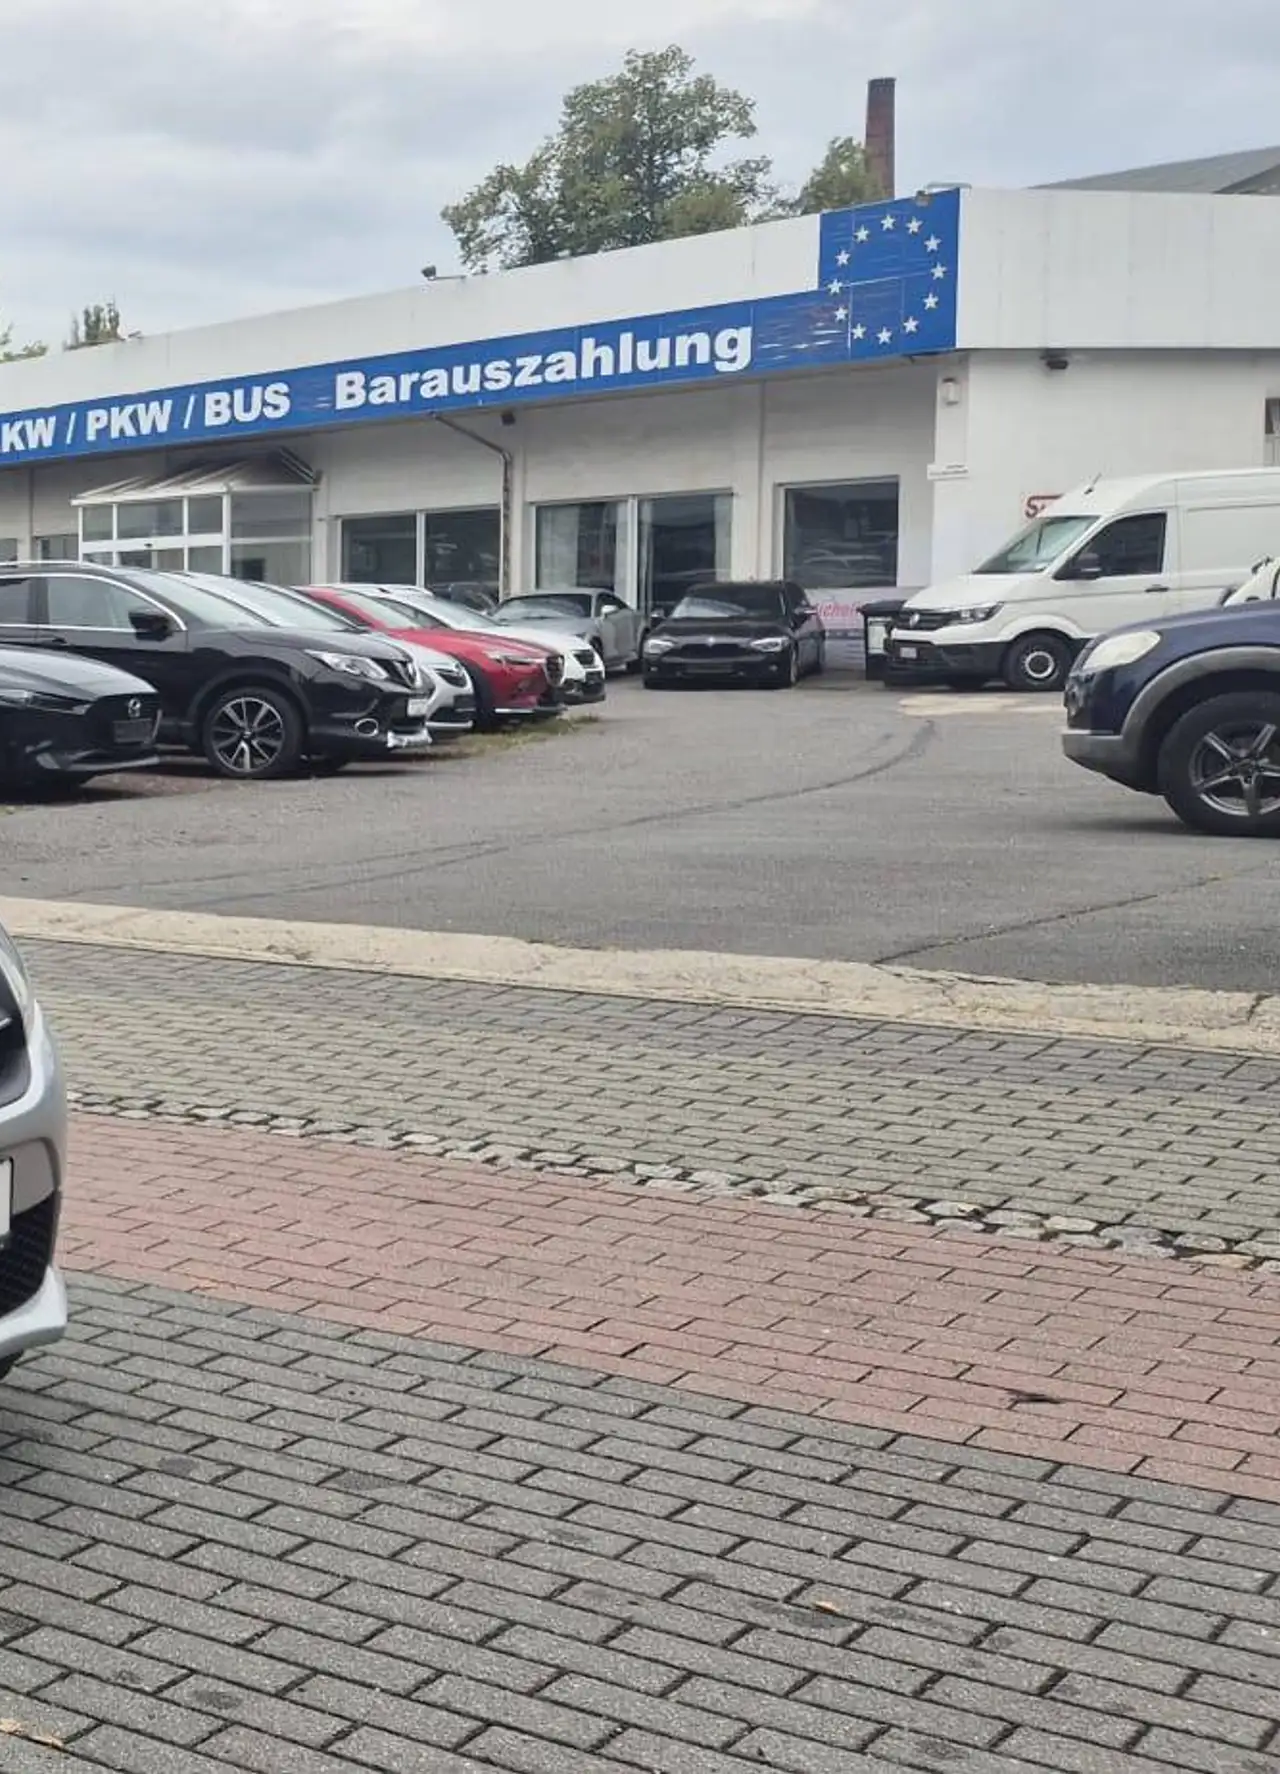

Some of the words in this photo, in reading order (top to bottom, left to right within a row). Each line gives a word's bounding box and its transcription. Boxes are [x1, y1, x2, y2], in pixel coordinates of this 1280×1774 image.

[86, 399, 172, 442] PKW
[204, 382, 292, 425] BUS
[335, 324, 753, 410] Barauszahlung
